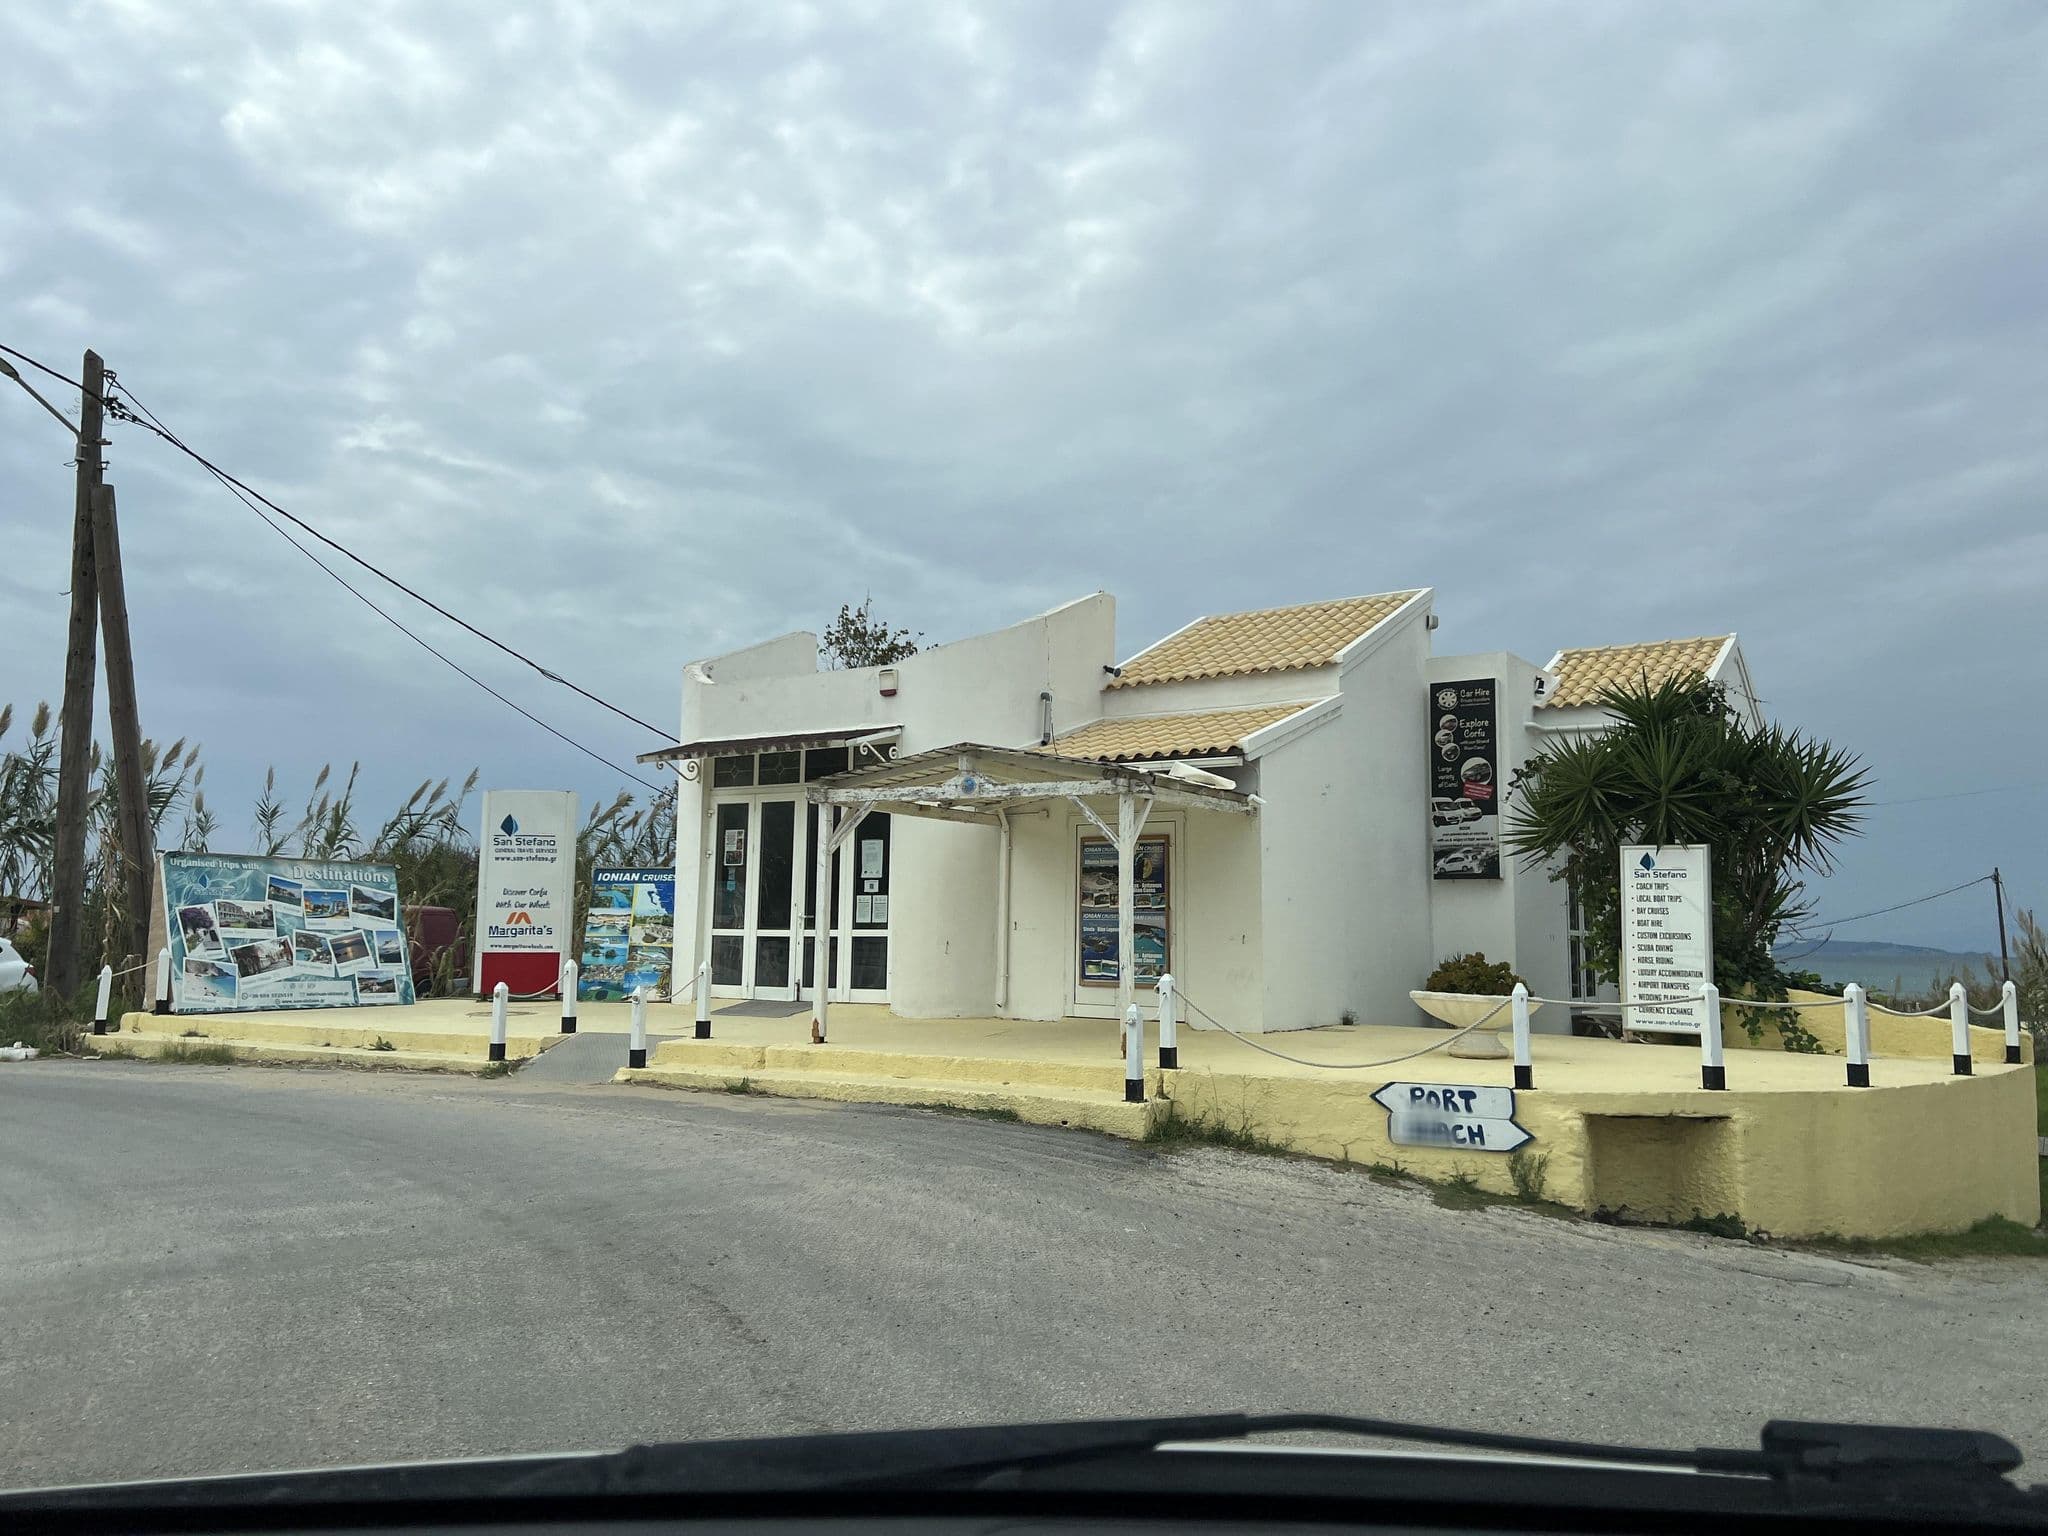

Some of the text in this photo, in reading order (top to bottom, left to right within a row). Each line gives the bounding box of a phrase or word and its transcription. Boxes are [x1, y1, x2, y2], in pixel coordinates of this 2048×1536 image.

[1460, 688, 1490, 698] Car Hire
[1459, 718, 1489, 729] Explore
[1464, 728, 1486, 738] Corfu
[493, 837, 556, 846] San Stefano
[218, 860, 240, 870] Trips
[241, 861, 259, 870] with
[292, 865, 389, 883] Destinations
[597, 872, 640, 881] IONIAN
[1634, 871, 1687, 879] San Stefano
[1636, 882, 1669, 890] COACH TRIPS
[529, 887, 548, 897] Corfu
[1653, 895, 1666, 903] BOAT
[1667, 895, 1682, 903] TRIPS
[1636, 907, 1669, 915] DAY CRUISES
[1637, 919, 1663, 927] BOAT HIRE
[488, 925, 553, 938] Margarita's
[1660, 932, 1692, 940] EXCURSIONS
[1637, 944, 1654, 952] SCUBA
[1637, 956, 1674, 965] HORSE RIDING
[1658, 970, 1704, 978] ACCOMMODATION
[1638, 981, 1690, 990] AIRPORT TRANSFERS
[1638, 993, 1662, 1001] WEDDING
[1638, 1006, 1694, 1016] CURRENCY EXCHANGE
[1409, 1086, 1478, 1113] PORT
